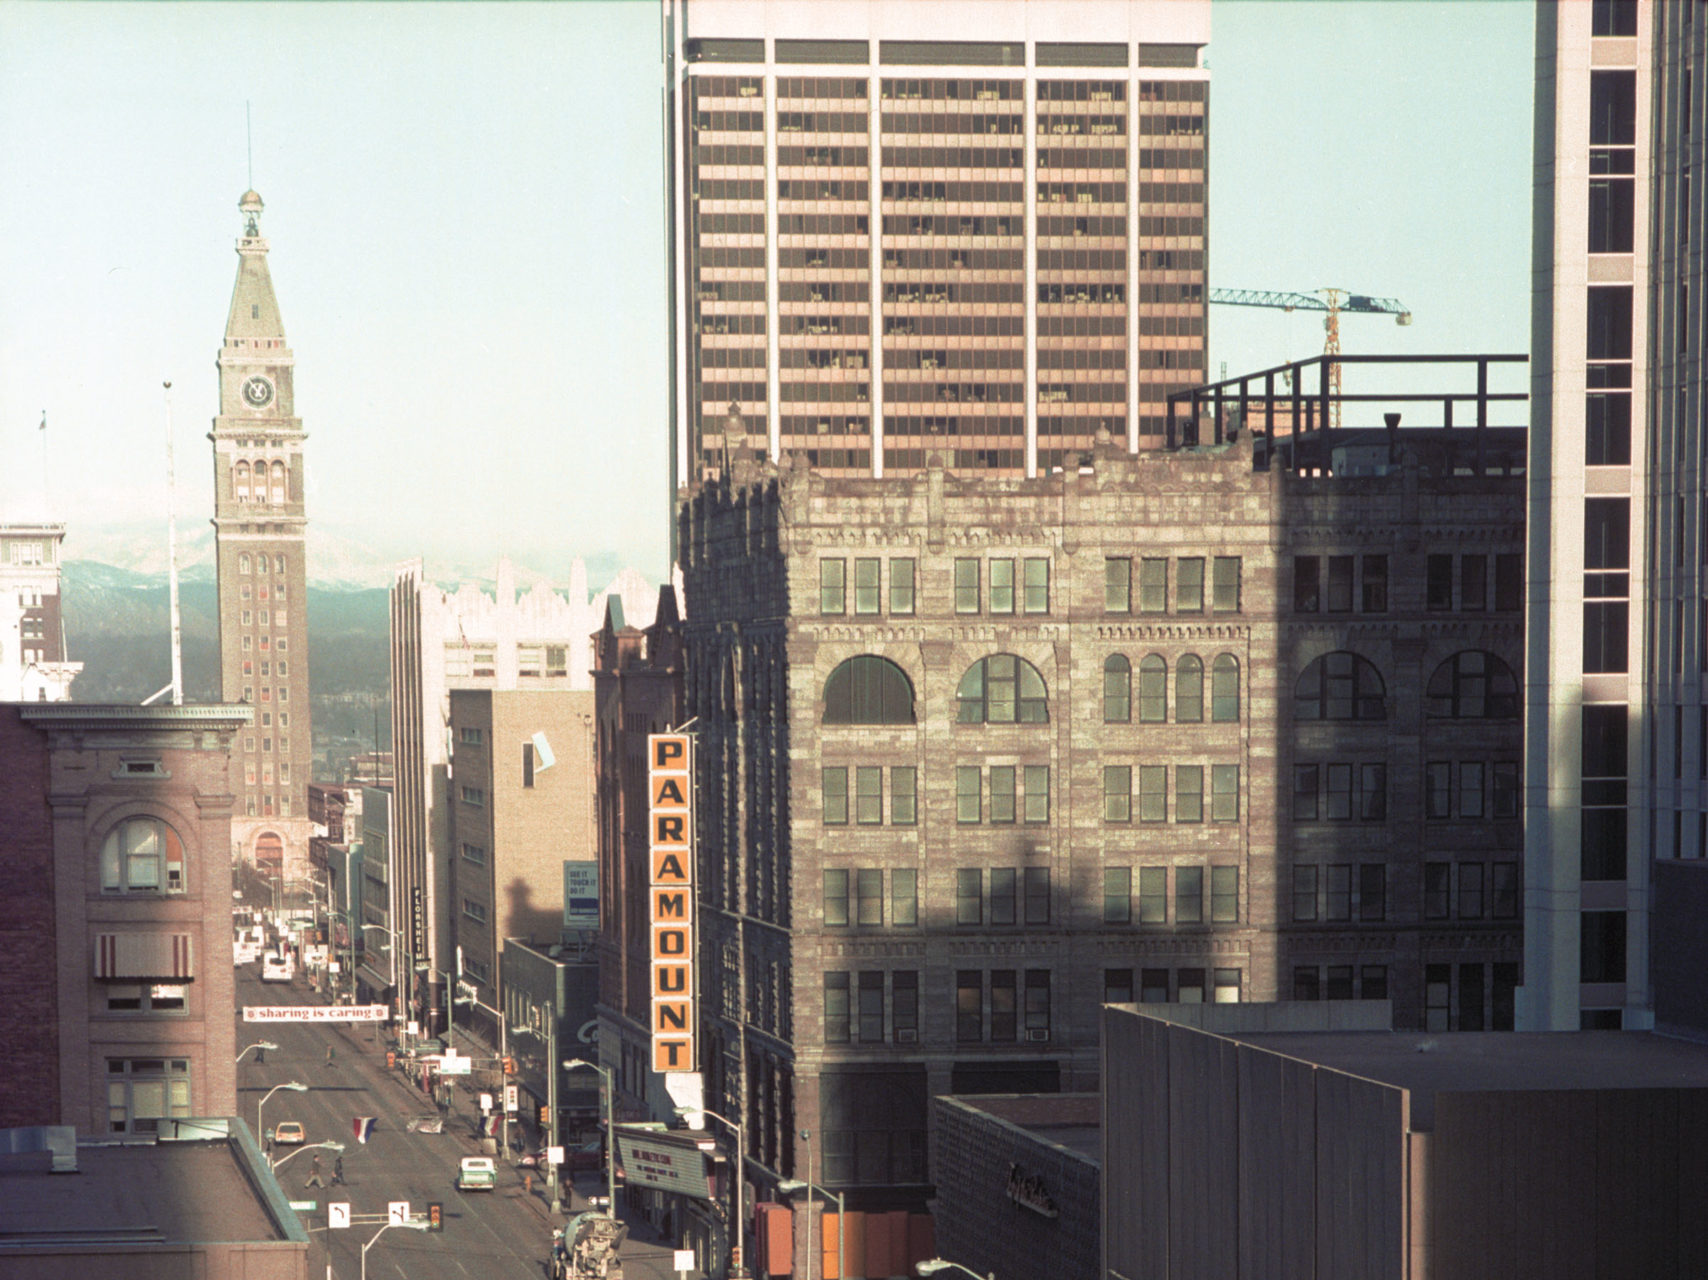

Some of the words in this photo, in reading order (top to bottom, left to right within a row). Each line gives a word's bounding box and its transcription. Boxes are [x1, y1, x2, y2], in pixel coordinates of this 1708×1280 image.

[656, 741, 686, 1066] PARAMOUNT
[259, 1008, 309, 1019] sharing
[313, 1007, 324, 1017] is
[329, 1007, 371, 1018] caring
